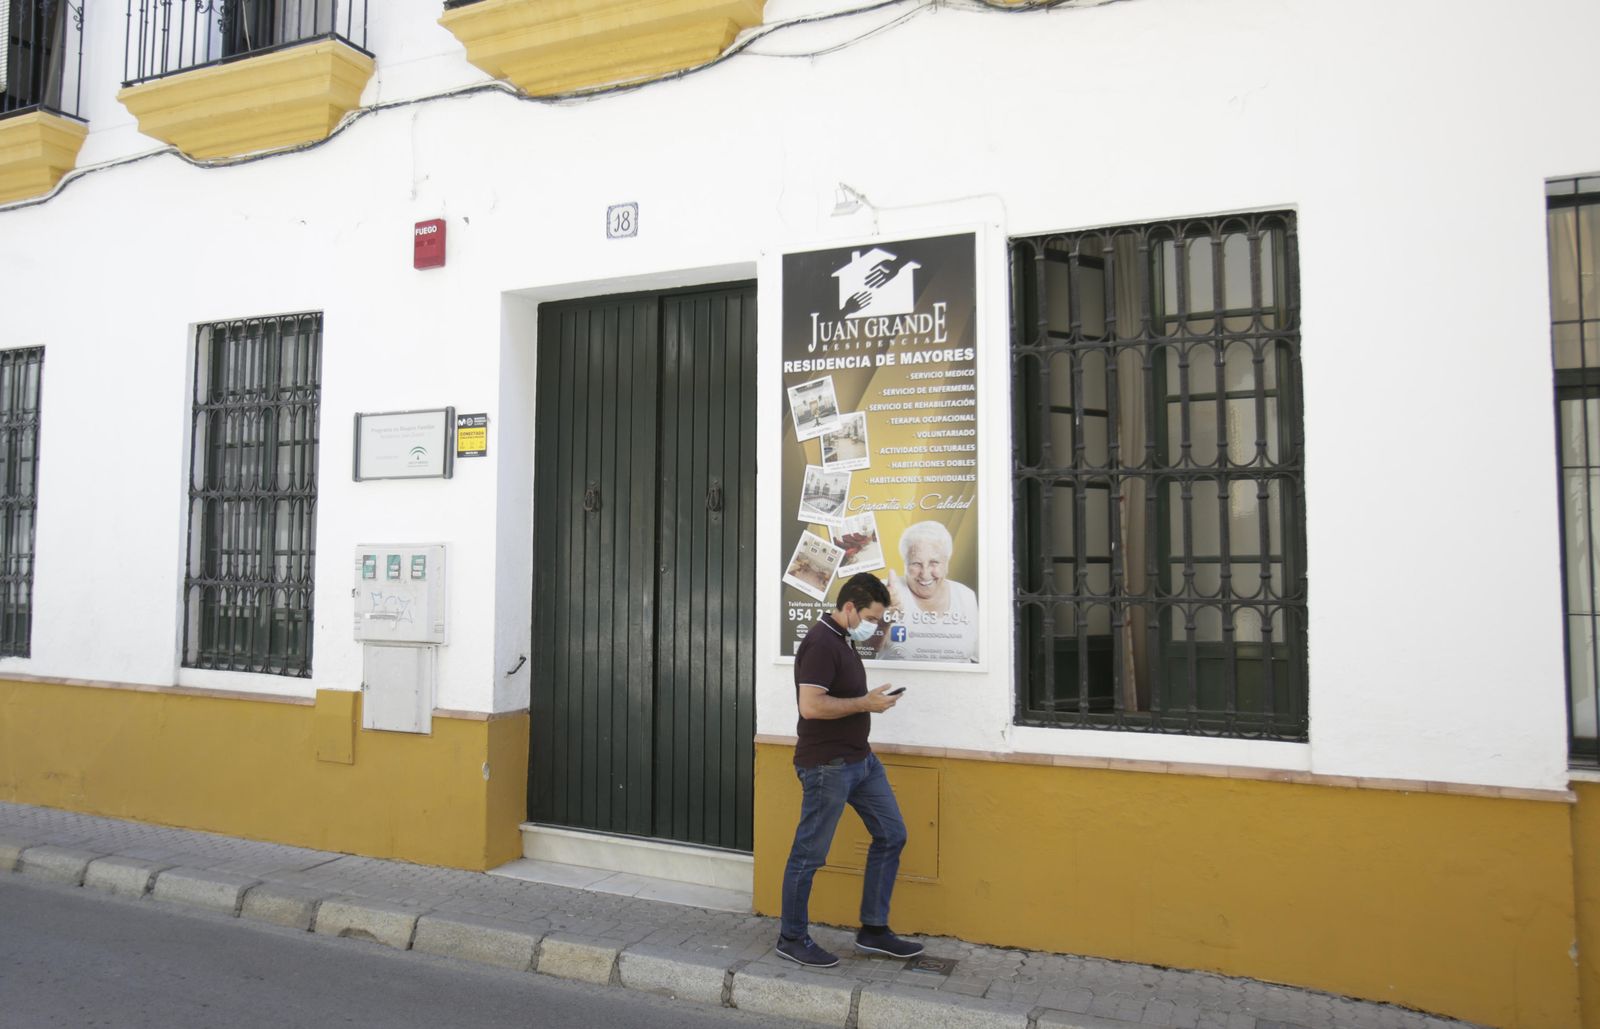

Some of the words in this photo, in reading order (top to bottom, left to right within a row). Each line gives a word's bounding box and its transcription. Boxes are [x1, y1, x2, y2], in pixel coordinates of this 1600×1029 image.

[613, 210, 631, 232] 18
[415, 225, 438, 236] FUEGO
[809, 313, 859, 352] JUAN
[864, 302, 948, 344] GRANDE
[822, 338, 934, 352] RESIDENCIA
[784, 355, 871, 373] RESIDENCIA
[875, 353, 896, 367] DE
[900, 347, 975, 365] MAYORES
[910, 371, 943, 380] SERVICIO
[945, 369, 975, 377] MEDICO
[883, 388, 915, 396] SERVICIO
[928, 384, 975, 393] ENFERMERIA
[869, 403, 901, 411] SERVICIO
[914, 398, 975, 408] REHABILITACIÓN
[890, 417, 920, 425] TERAPIA
[922, 414, 975, 423] OCUPACIONAL
[917, 429, 975, 438] VOLUNTARIADO
[880, 446, 927, 455] ACTIVIDADES
[929, 444, 975, 452] CULTURALES
[891, 461, 945, 469] HABITACIONES
[947, 459, 975, 467] DOBLES
[869, 475, 921, 484] HABITACIONES
[923, 474, 975, 483] INDIVIDUALES
[788, 608, 812, 621] 954
[883, 609, 906, 624] 647
[912, 610, 937, 625] 963
